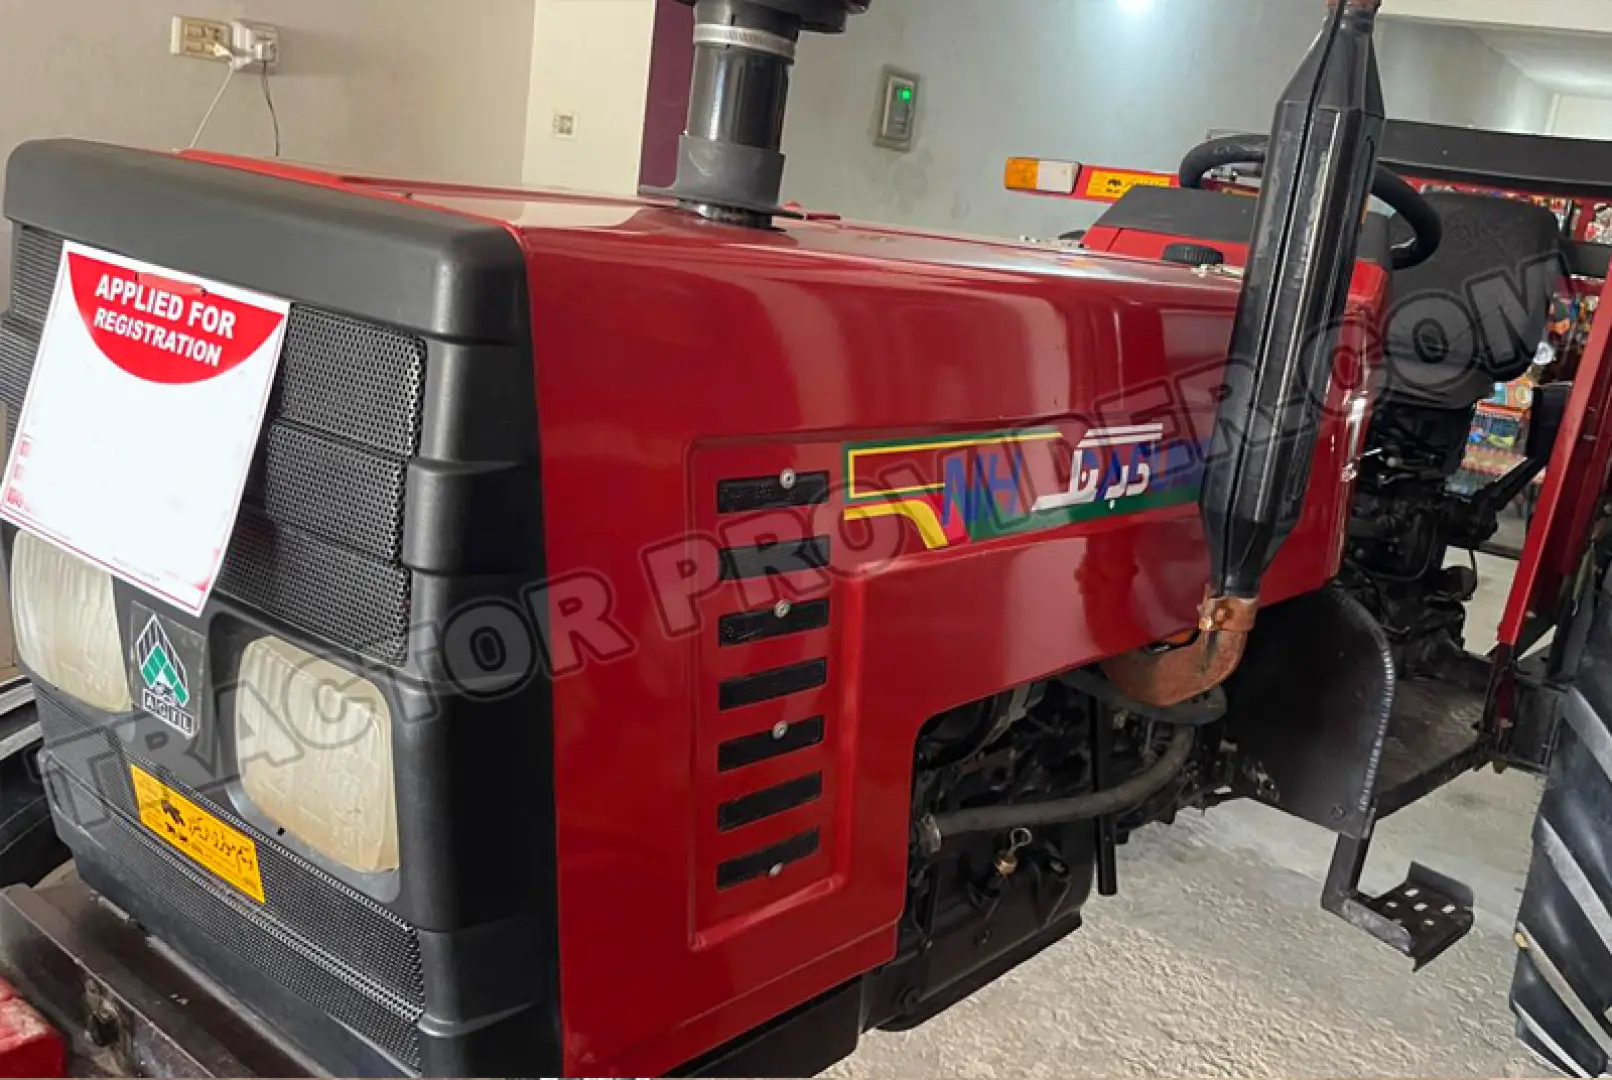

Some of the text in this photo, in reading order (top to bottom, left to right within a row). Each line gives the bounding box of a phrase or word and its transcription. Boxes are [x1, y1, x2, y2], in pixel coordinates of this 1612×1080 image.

[94, 273, 237, 339] APPLIED FOR
[94, 306, 223, 368] REGISTRATION
